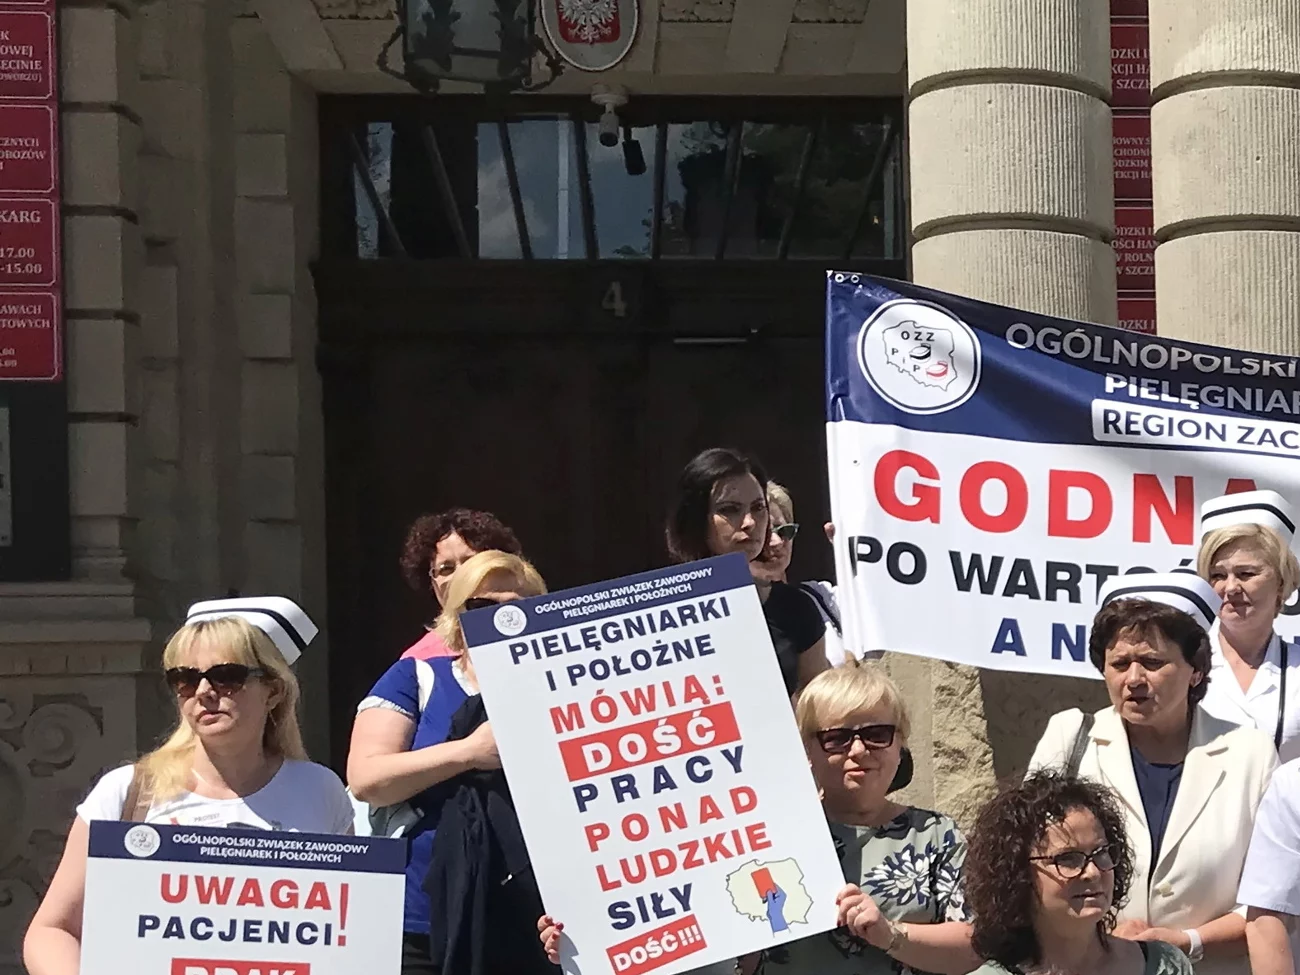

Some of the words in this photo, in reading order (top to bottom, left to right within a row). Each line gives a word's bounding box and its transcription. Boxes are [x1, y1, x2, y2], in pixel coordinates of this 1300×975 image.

[1005, 322, 1297, 378] OGÓLNOPOLSKI
[1103, 409, 1227, 442] REGION
[874, 449, 1257, 545] GODN
[848, 536, 927, 585] PO
[535, 592, 610, 614] OGÓLNOPOLSKI
[610, 581, 653, 599] ZWIĄZEK
[654, 567, 712, 589] ZAWODOWY
[562, 598, 629, 619] PIELĘGNIAREK
[635, 584, 692, 604] POŁOŻNYCH
[508, 597, 731, 665] PIELĘGNIARKI
[990, 617, 1027, 657] A
[546, 671, 557, 691] I
[567, 634, 716, 686] POŁOŻNE
[550, 674, 725, 734] MÓWIĄ:
[582, 710, 716, 773] DOŚĆ
[573, 746, 745, 813] PRACY
[173, 833, 255, 847] OGÓLNOPOLSKI
[258, 839, 303, 851] ZWIĄZEK
[305, 843, 369, 854] ZAWODOWY
[585, 785, 758, 852] PONAD
[200, 846, 272, 859] PIELĘGNIAREK
[280, 850, 341, 863] POŁOŻNYCH
[596, 822, 772, 892] LUDZKIE
[607, 883, 694, 931] SIŁY
